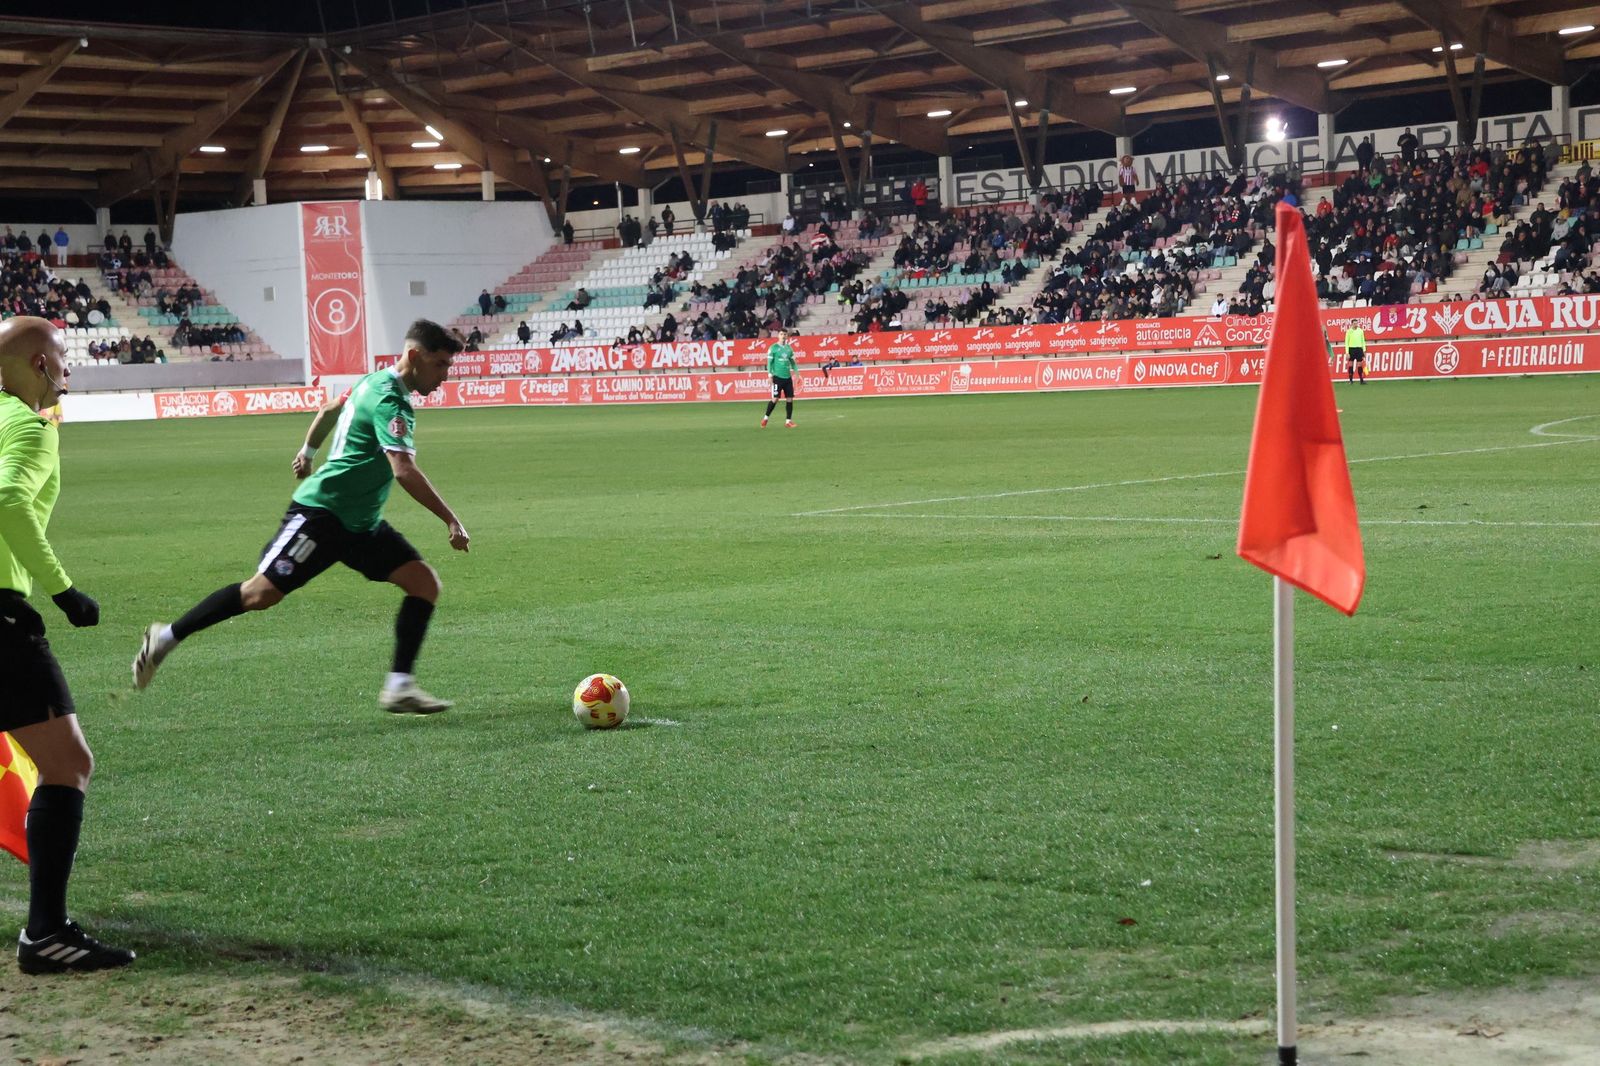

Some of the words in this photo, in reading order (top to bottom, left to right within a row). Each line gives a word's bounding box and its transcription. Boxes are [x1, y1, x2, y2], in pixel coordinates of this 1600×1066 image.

[311, 272, 359, 281] MONTETORO
[328, 298, 346, 325] 8
[1463, 299, 1543, 331] CAJA
[1550, 295, 1600, 328] RU
[1326, 316, 1372, 327] CARPINERÍA
[966, 341, 1002, 351] sangregorio
[1005, 339, 1041, 350] sangregorio
[1049, 337, 1086, 349] sangregorio
[1089, 335, 1128, 346] sangregorio
[651, 341, 712, 368] ZAMORA
[713, 340, 735, 366] CF
[813, 349, 845, 358] sangregorio
[848, 347, 881, 356] sangregorio
[888, 345, 921, 354] sangregorio
[924, 344, 959, 353] sangregorio
[1497, 341, 1585, 367] FEDERACIÓN
[550, 347, 607, 372] ZAMORA
[608, 347, 628, 369] CF
[1335, 348, 1414, 373] FERACIÓN
[1056, 367, 1093, 381] INNOVA
[1095, 366, 1123, 382] Chef
[1149, 362, 1188, 377] INNOVA
[1190, 361, 1219, 378] Chef
[612, 379, 644, 392] CAMINO
[645, 379, 656, 391] DE
[657, 378, 667, 391] LA
[669, 377, 693, 391] PLATA
[734, 378, 771, 390] VALDERA
[803, 377, 825, 387] ELOY
[826, 373, 864, 386] ÁLVAREZ
[466, 381, 505, 398] Freigel
[528, 378, 569, 396] Freigel
[159, 394, 209, 406] FUNDACIÓN
[244, 391, 301, 411] ZAMORA
[304, 390, 324, 409] CF
[603, 392, 629, 400] Morales
[629, 392, 639, 400] del
[640, 392, 654, 400] Vino
[655, 391, 686, 400] (Zamora)
[162, 405, 209, 417] ZAMORACF
[287, 533, 318, 563] 10
